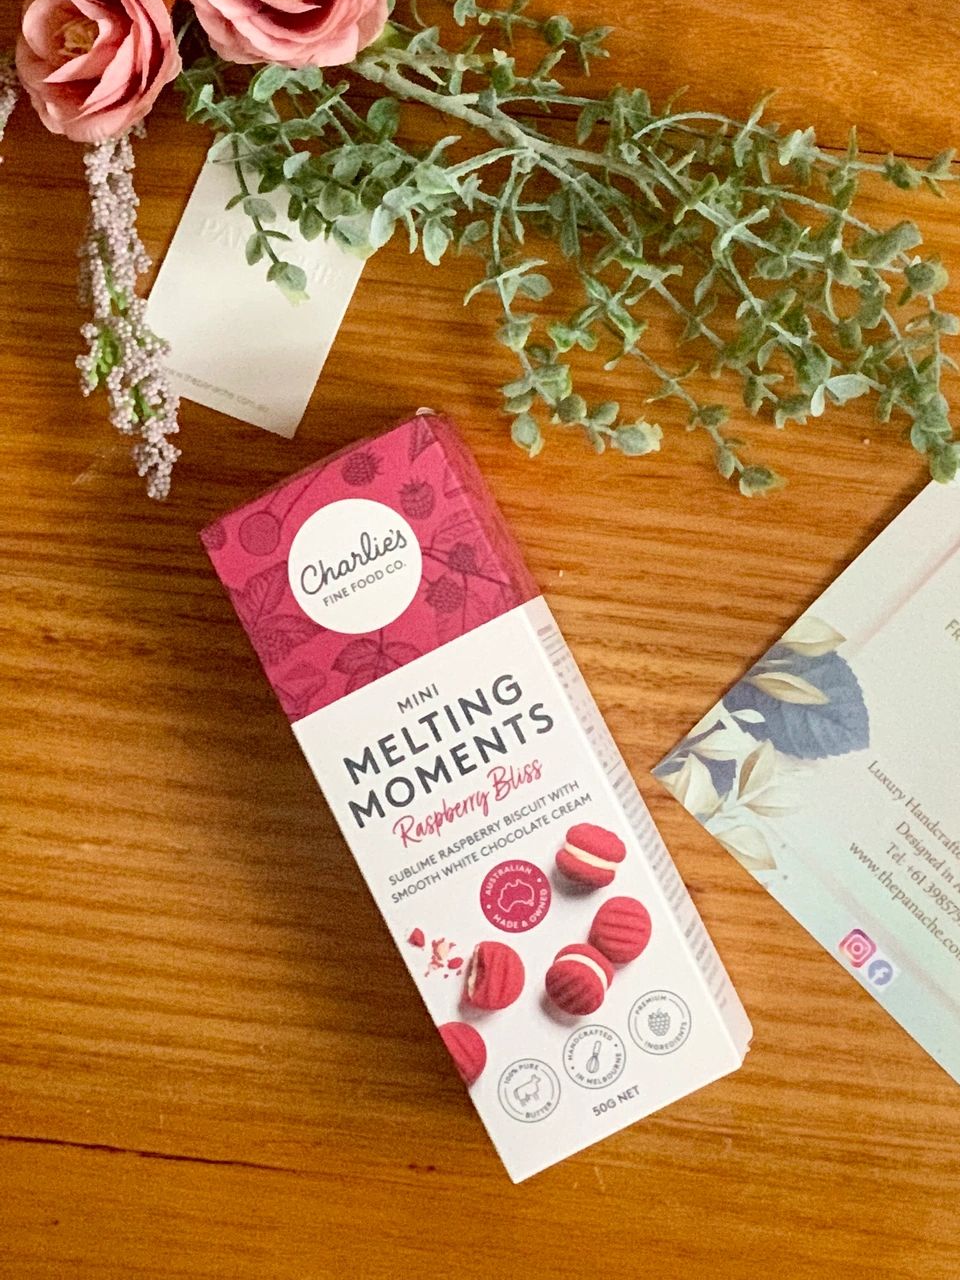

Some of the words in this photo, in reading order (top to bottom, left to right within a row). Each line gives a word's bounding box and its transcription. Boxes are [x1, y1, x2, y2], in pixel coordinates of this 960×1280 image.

[301, 529, 407, 595] Charlie's
[322, 587, 350, 607] FINE
[350, 570, 384, 592] FOOD
[385, 560, 407, 574] CO.
[396, 682, 440, 714] MINI
[343, 673, 523, 785] MELTING
[348, 702, 554, 829] MOMENTS
[867, 760, 906, 801] Luxury
[392, 789, 490, 848] Raspberry
[486, 759, 543, 802] Bliss
[388, 855, 439, 886] SUBLIME
[438, 821, 501, 860] RASPBERRY
[503, 796, 546, 827] BISCUIT
[546, 780, 580, 803] WITH
[391, 872, 442, 904] SMOOTH
[442, 852, 480, 878] WHITE
[481, 815, 551, 857] CHOCOLATE
[552, 792, 593, 821] CREAM
[896, 821, 946, 871] Designed
[941, 869, 954, 883] in
[485, 865, 532, 896] AUSTRALIAN
[907, 864, 927, 886] +61
[493, 914, 520, 928] MADE
[529, 889, 548, 923] OWNED
[635, 995, 667, 1015] PREMIUM
[567, 1029, 613, 1061] HANDCRAFTED
[644, 1021, 688, 1051] INGREDIENTS
[518, 1063, 540, 1071] PURE
[575, 1072, 585, 1082] IN
[586, 1052, 622, 1085] MELBOURNE
[525, 1100, 553, 1119] BUTTER
[592, 1099, 617, 1117] 50G
[617, 1085, 641, 1104] NET
